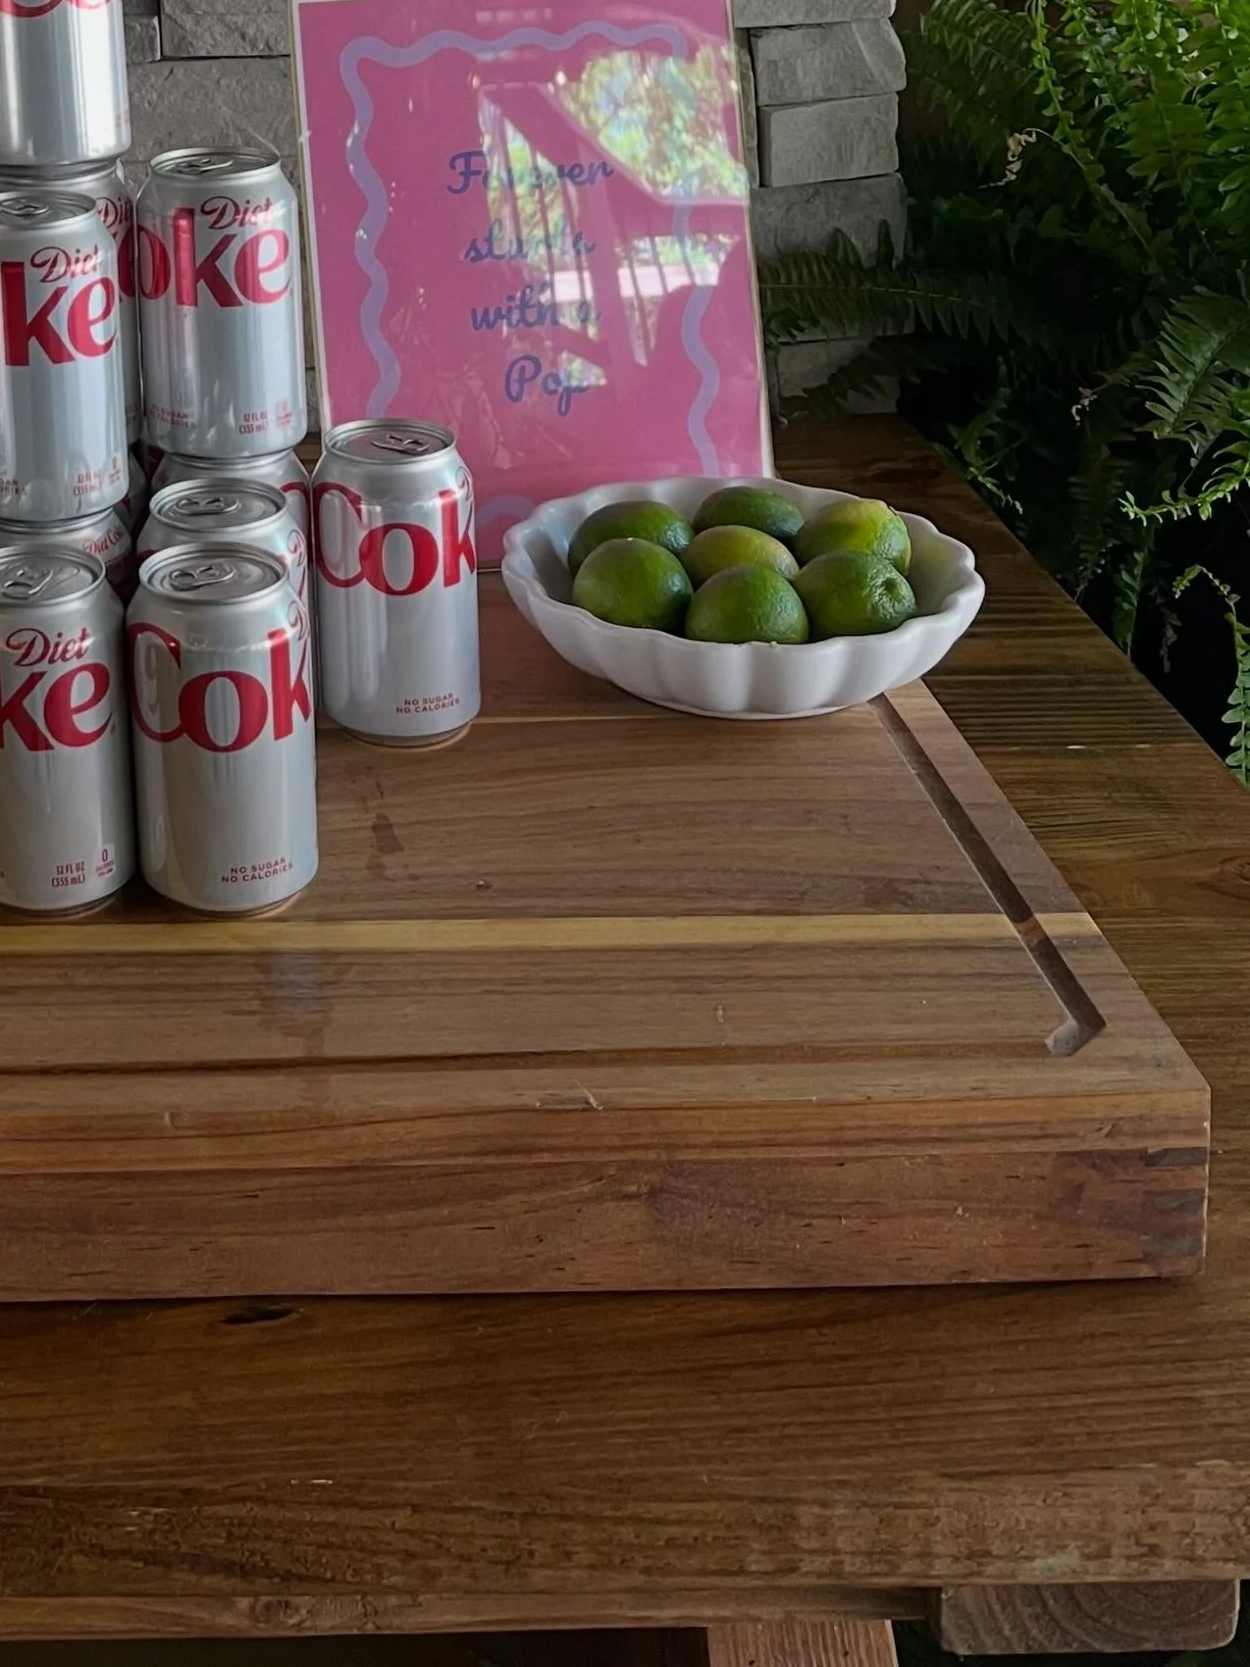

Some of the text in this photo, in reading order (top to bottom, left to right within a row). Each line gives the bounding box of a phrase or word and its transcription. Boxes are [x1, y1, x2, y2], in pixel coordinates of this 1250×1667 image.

[199, 195, 274, 230] Diet
[30, 244, 102, 283] Diet
[139, 206, 291, 308] oke
[504, 354, 592, 417] Pop
[312, 482, 475, 597] Cok
[6, 626, 92, 667] Diet
[127, 622, 311, 753] Cok
[404, 692, 454, 707] NO SUGAR
[396, 698, 460, 714] NO CALORIES
[52, 873, 86, 888] (355 mL)
[55, 864, 64, 875] 12
[65, 863, 73, 874] FL
[75, 861, 85, 873] OZ
[221, 862, 293, 884] NO CALORIES
[230, 856, 286, 875] NO SUGAR
